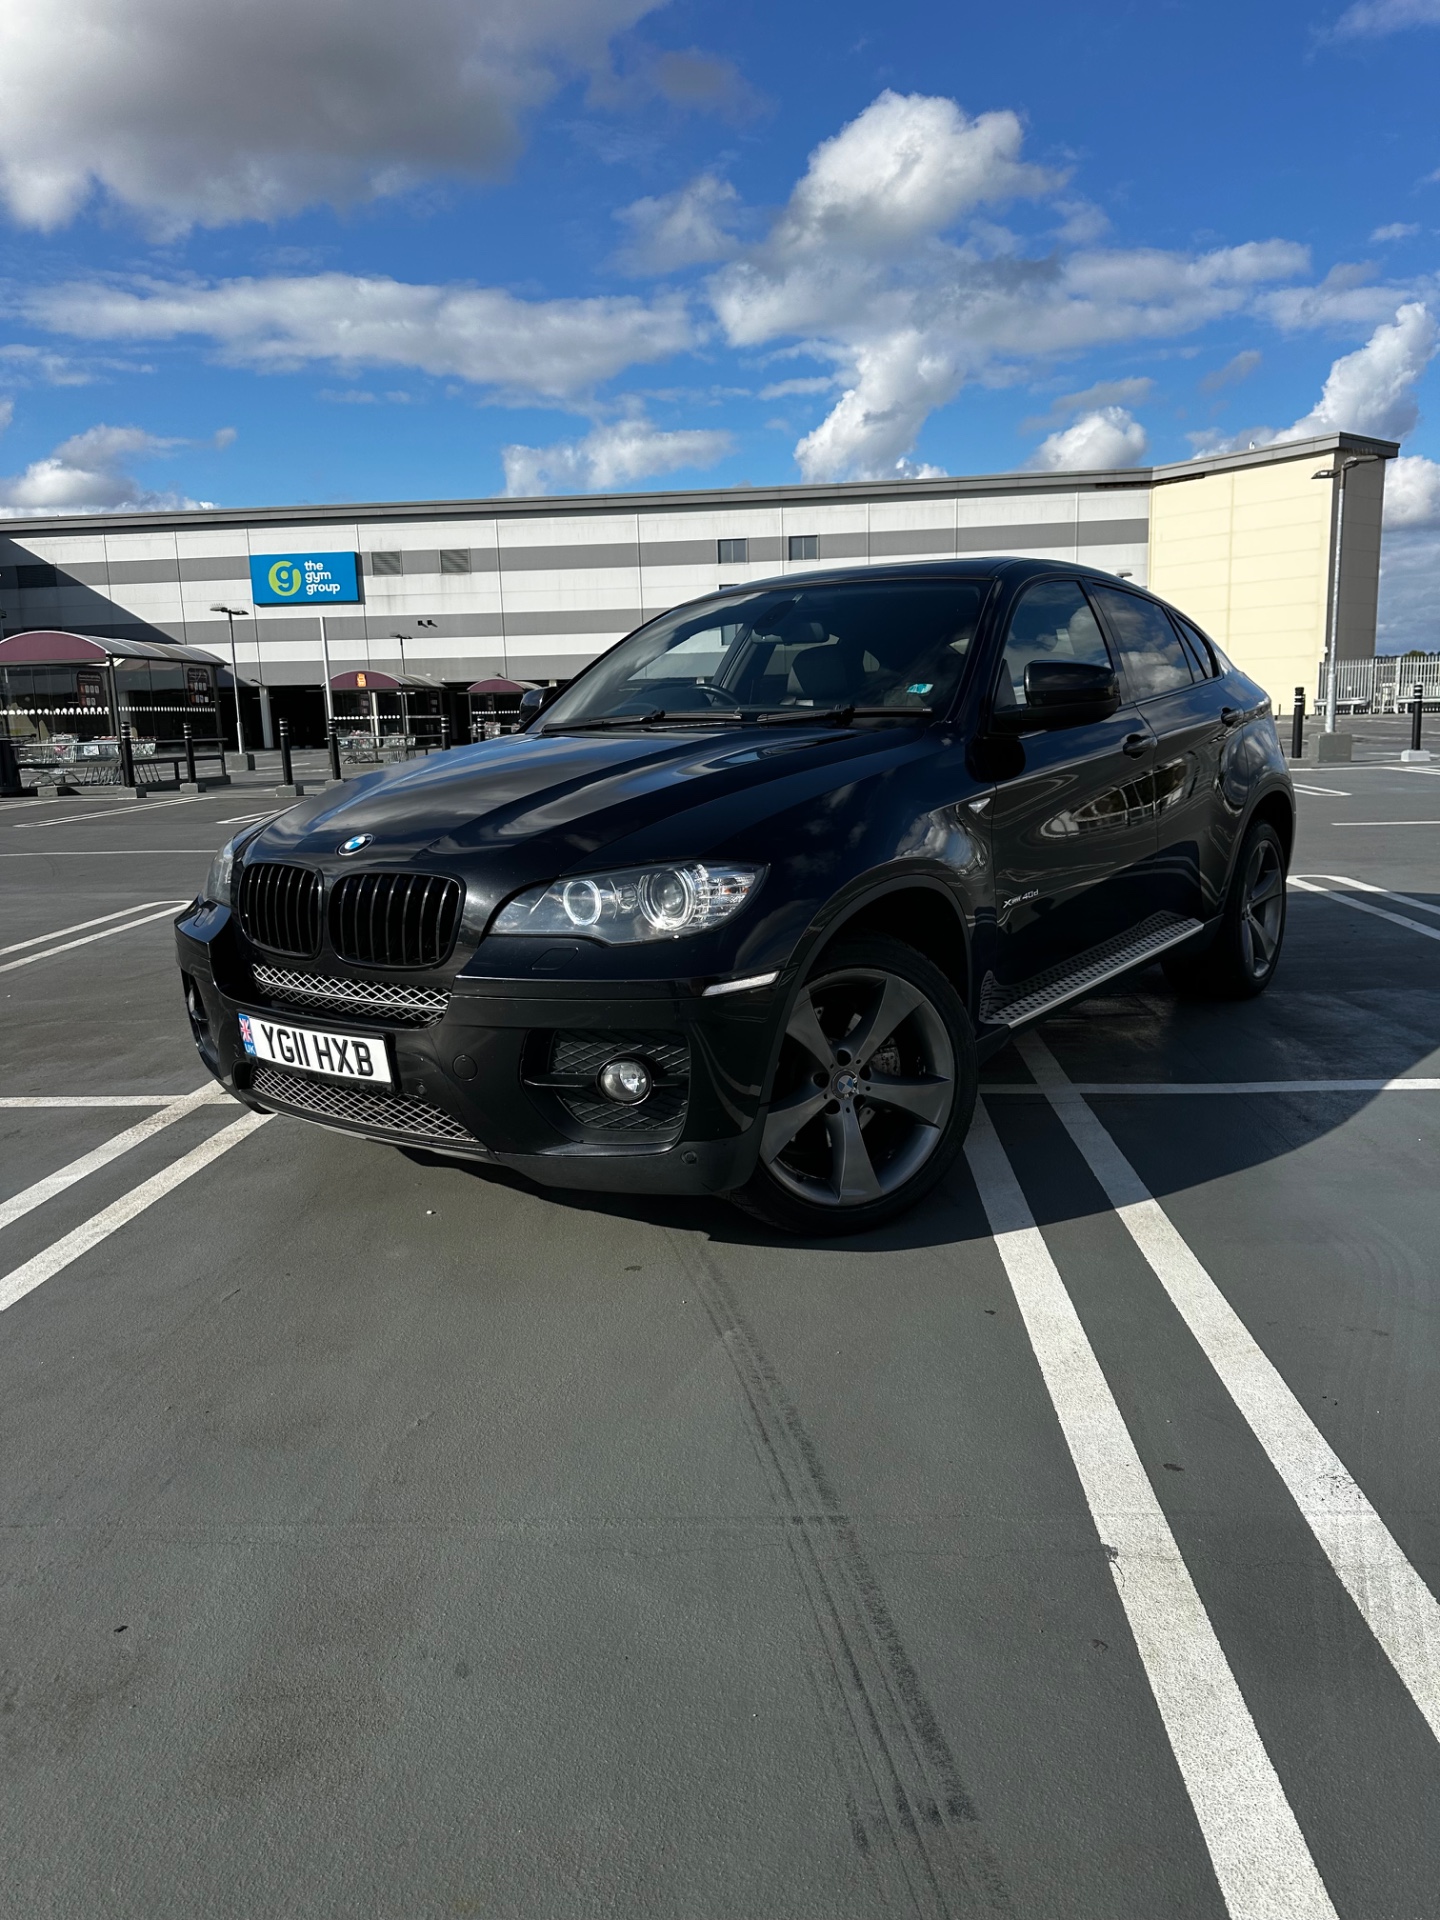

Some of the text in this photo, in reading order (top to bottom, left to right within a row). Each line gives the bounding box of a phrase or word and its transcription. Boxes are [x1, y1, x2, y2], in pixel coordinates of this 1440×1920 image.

[304, 560, 323, 570] the
[305, 571, 331, 582] gym
[306, 583, 340, 595] group
[244, 1043, 256, 1054] UK
[312, 1035, 373, 1077] HXB
